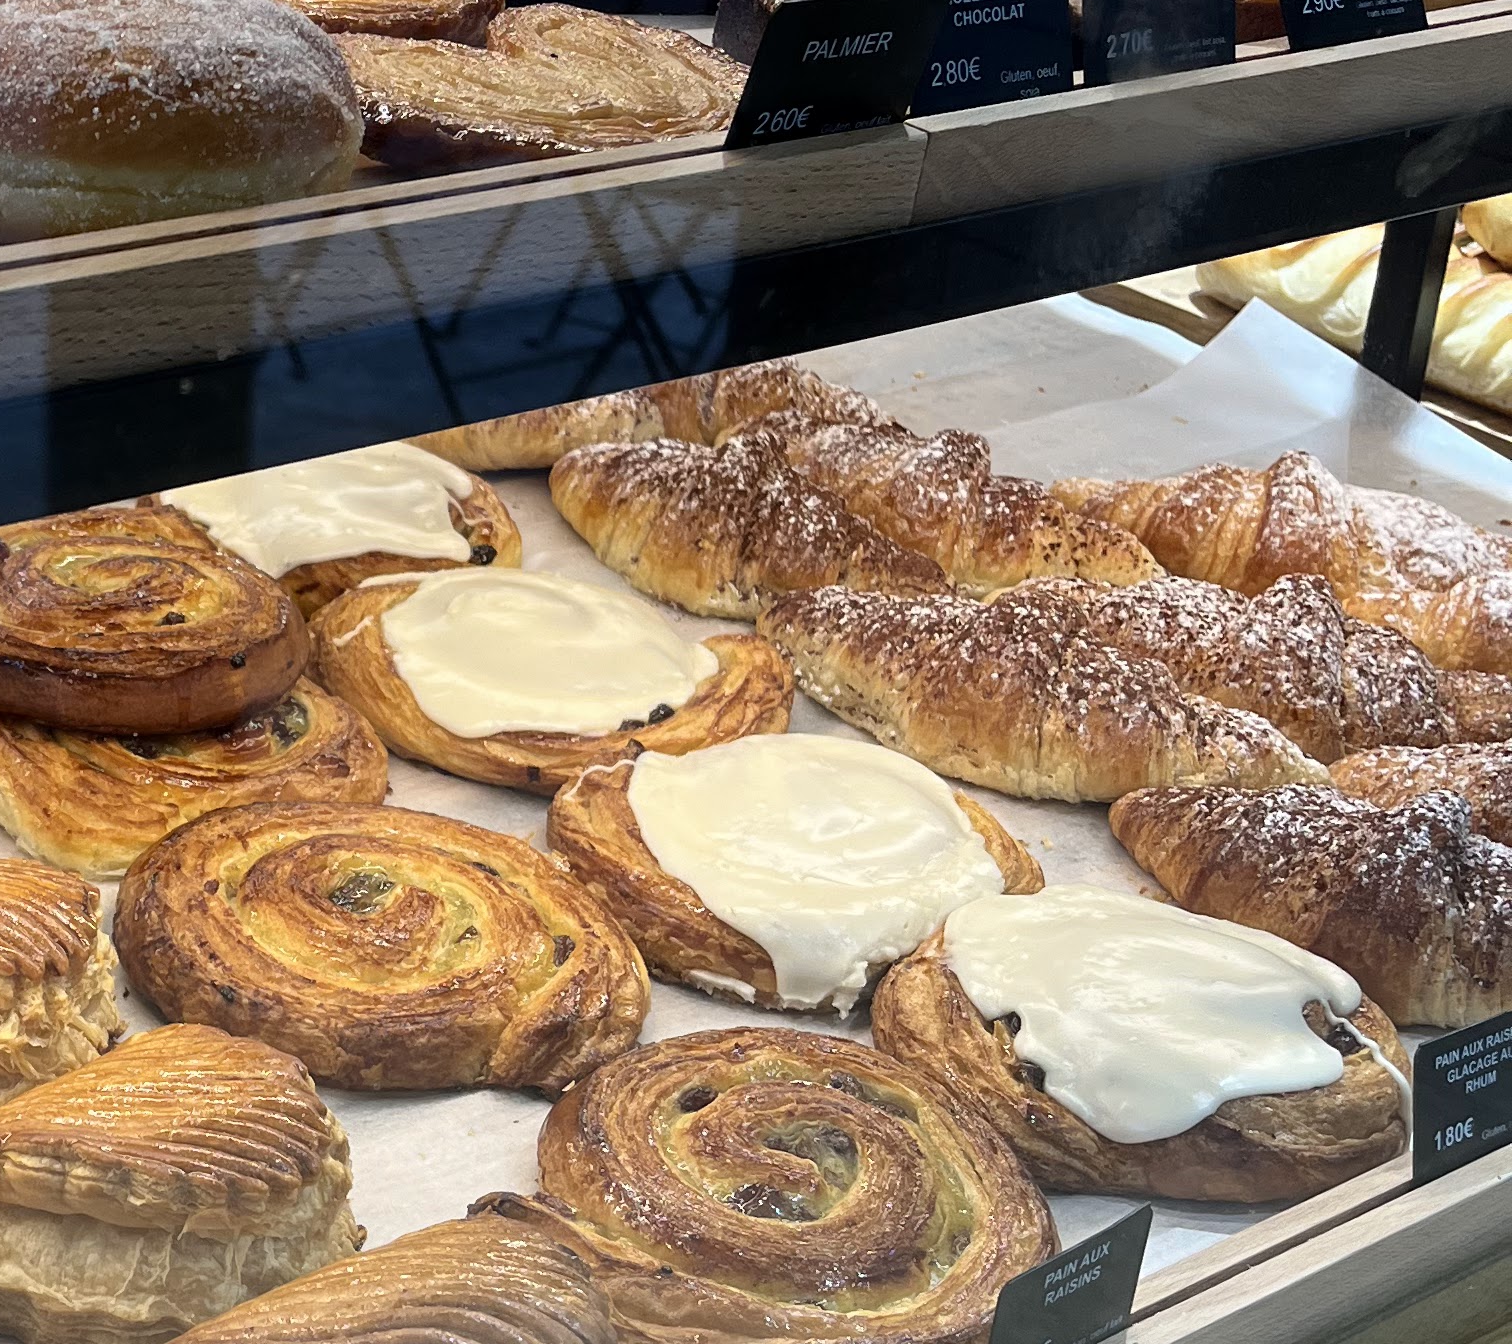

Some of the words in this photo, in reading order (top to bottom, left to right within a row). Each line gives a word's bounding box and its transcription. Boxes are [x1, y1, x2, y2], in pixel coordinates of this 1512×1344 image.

[953, 3, 1026, 27] CHOCOLAT
[802, 32, 893, 62] PALMIER
[931, 56, 981, 87] 2,80€
[1435, 1047, 1460, 1070] PAIN
[1462, 1038, 1484, 1061] AUX
[1447, 1051, 1499, 1083] GLACAGE
[1466, 1070, 1497, 1094] RHUM
[1044, 1260, 1077, 1289] PAIN
[1080, 1241, 1112, 1269] AUX
[1044, 1265, 1102, 1307] RAISINS
